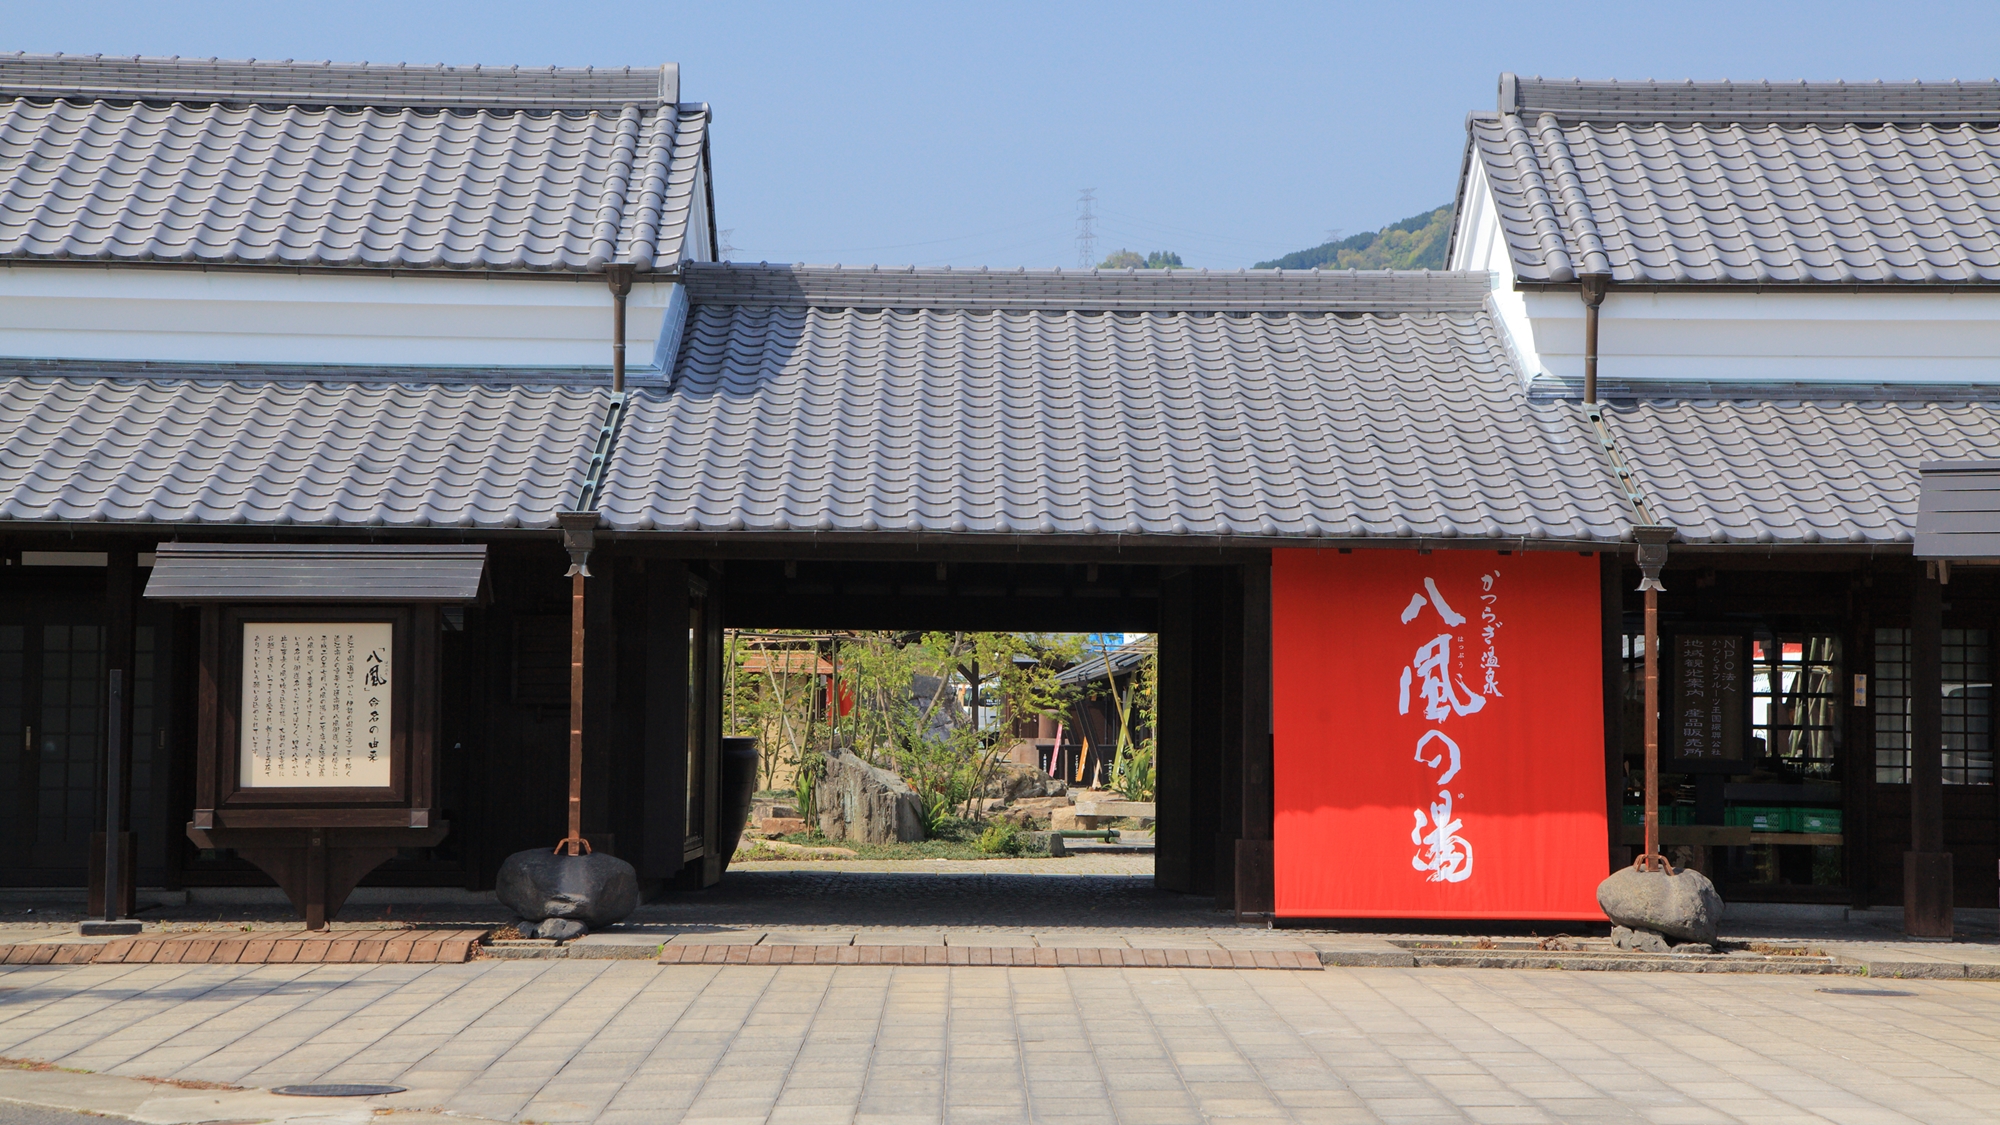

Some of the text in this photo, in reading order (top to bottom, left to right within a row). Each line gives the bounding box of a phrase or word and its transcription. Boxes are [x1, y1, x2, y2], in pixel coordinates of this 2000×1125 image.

[1480, 569, 1504, 698] かつらぎ温泉
[1722, 639, 1737, 692] NPO法人
[1398, 576, 1487, 883] 八風の湯
[1683, 639, 1705, 757] 地域観光案内・産品販売所
